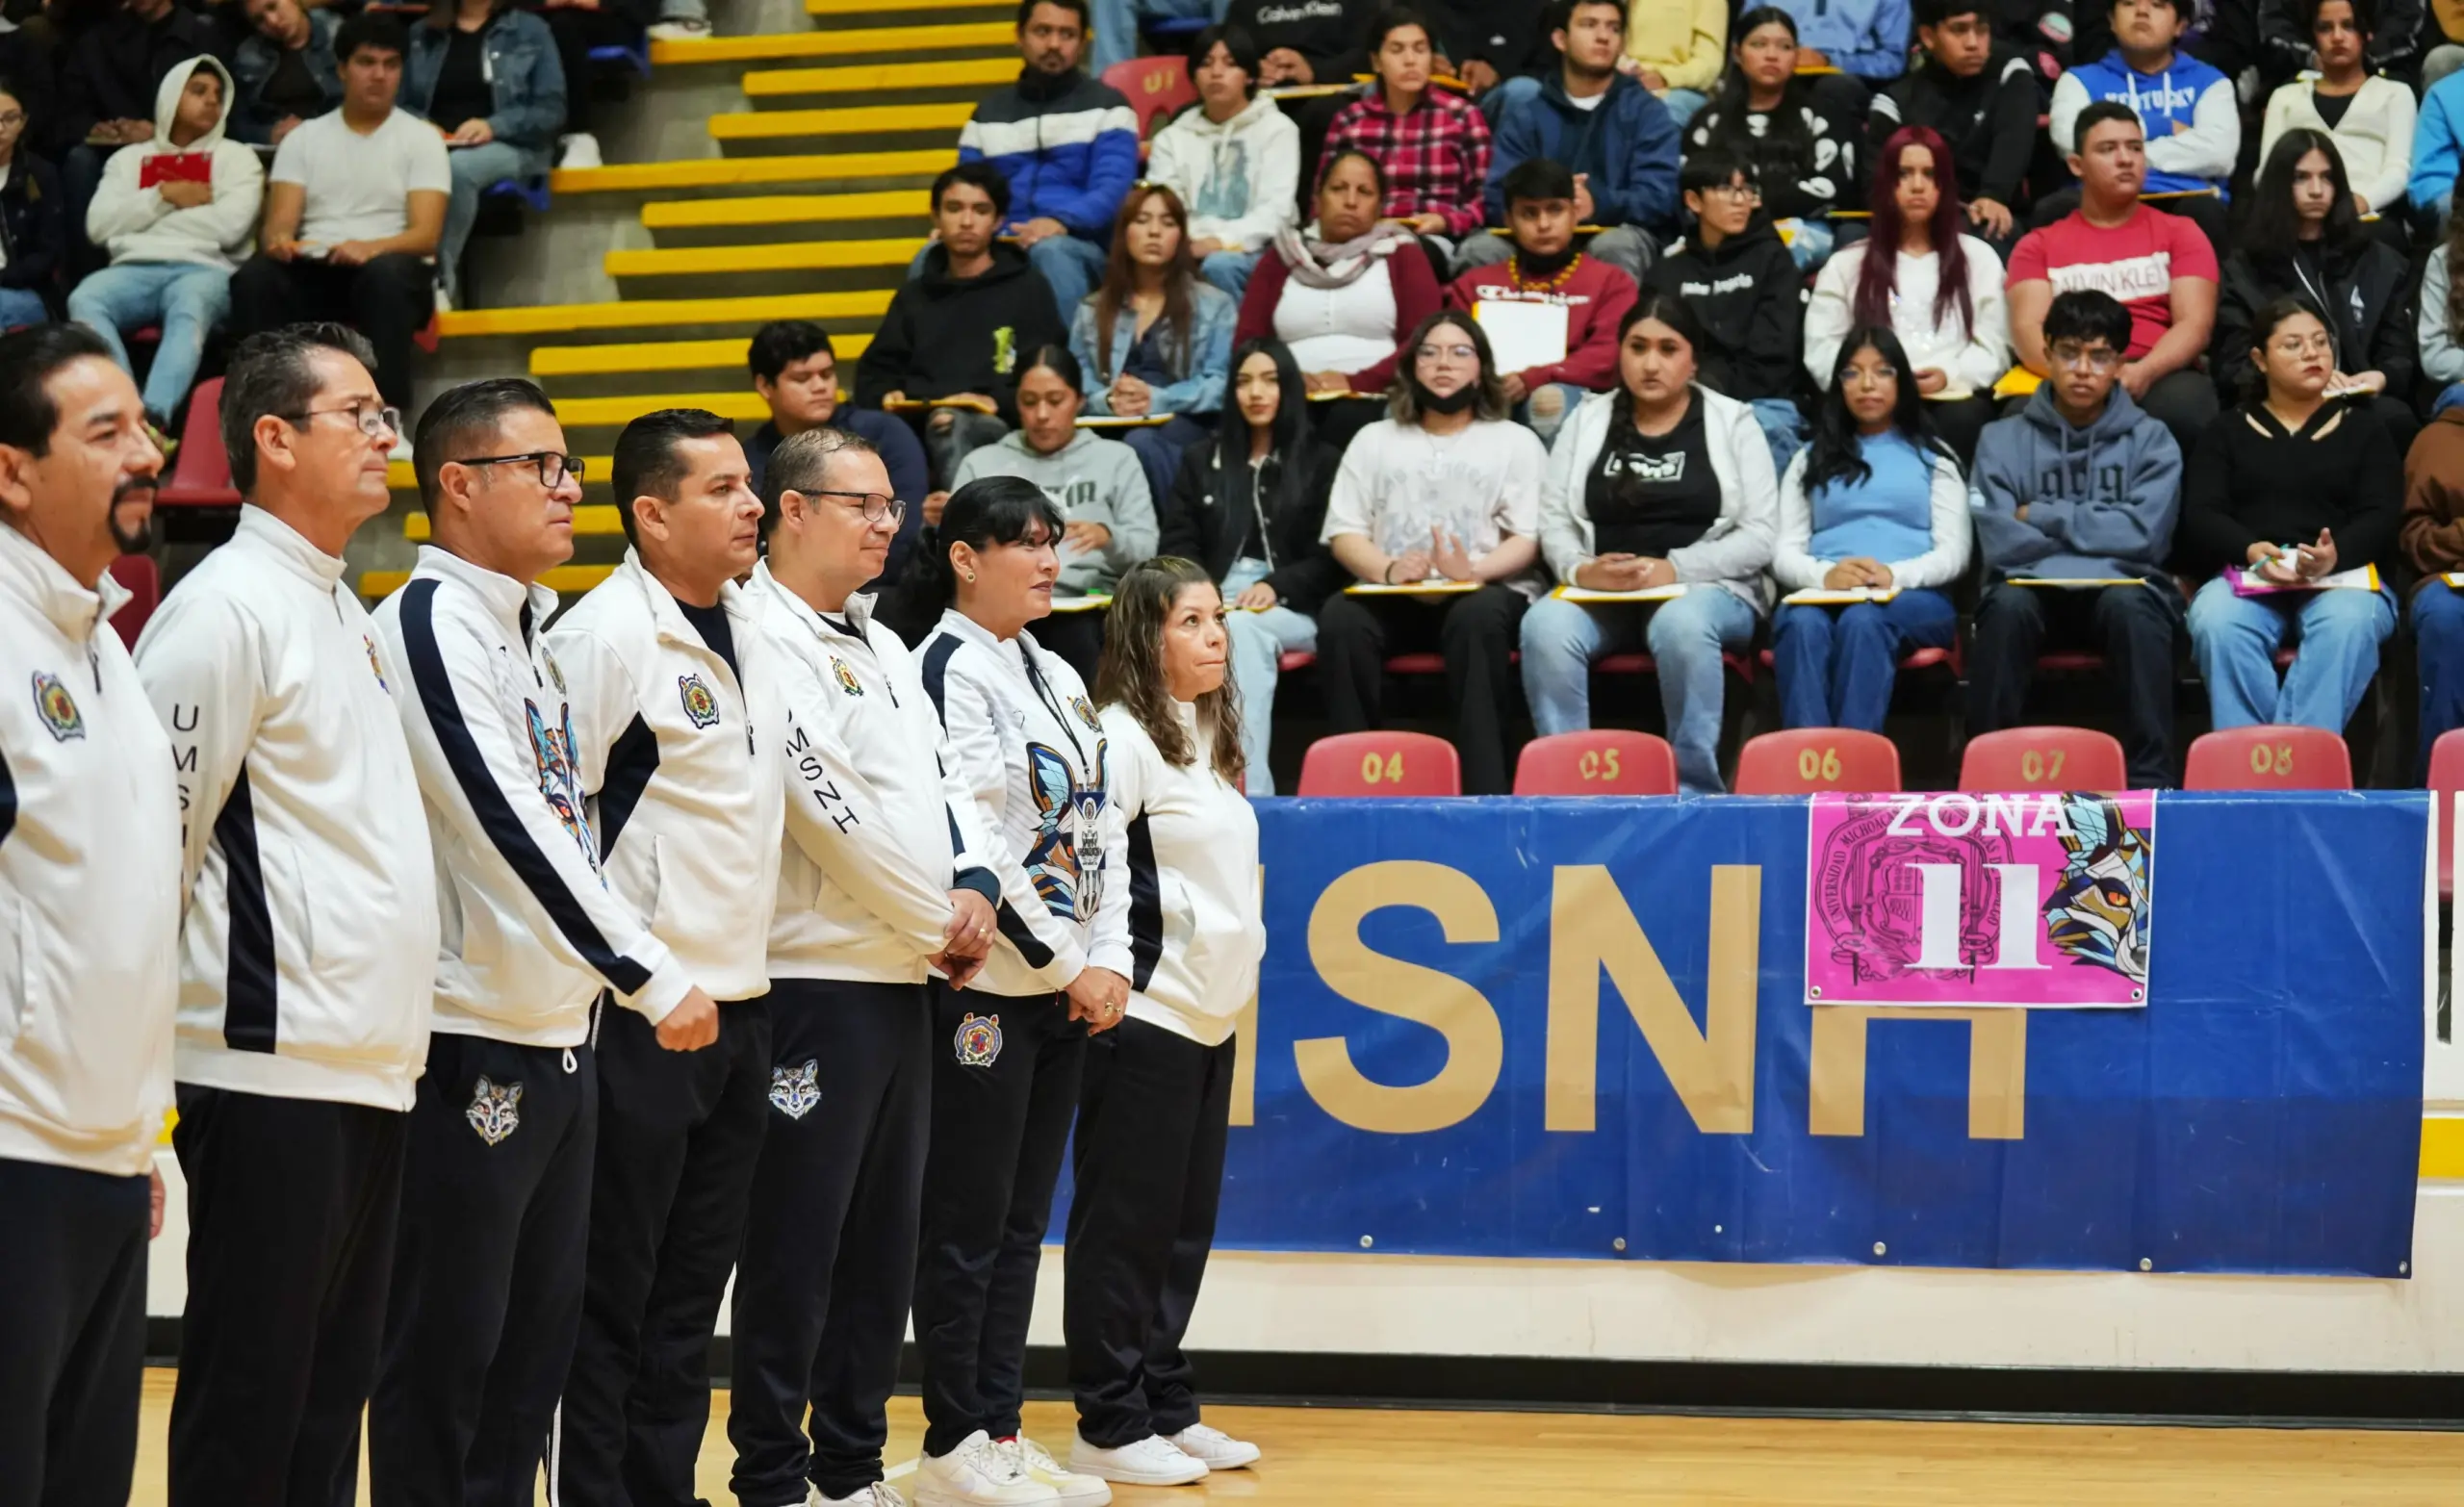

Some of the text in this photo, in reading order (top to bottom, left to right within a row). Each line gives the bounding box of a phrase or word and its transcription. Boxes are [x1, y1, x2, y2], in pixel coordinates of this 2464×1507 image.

[171, 702, 200, 849] UMS
[785, 708, 860, 834] MSNH
[1362, 752, 1404, 784] 04
[1579, 748, 1620, 781] 05
[1799, 747, 1841, 782] 06
[2021, 749, 2066, 783] 07
[2250, 741, 2294, 777] 08
[1886, 793, 2075, 836] ZONA
[1904, 862, 2053, 970] 11
[1229, 857, 2027, 1140] SNH
